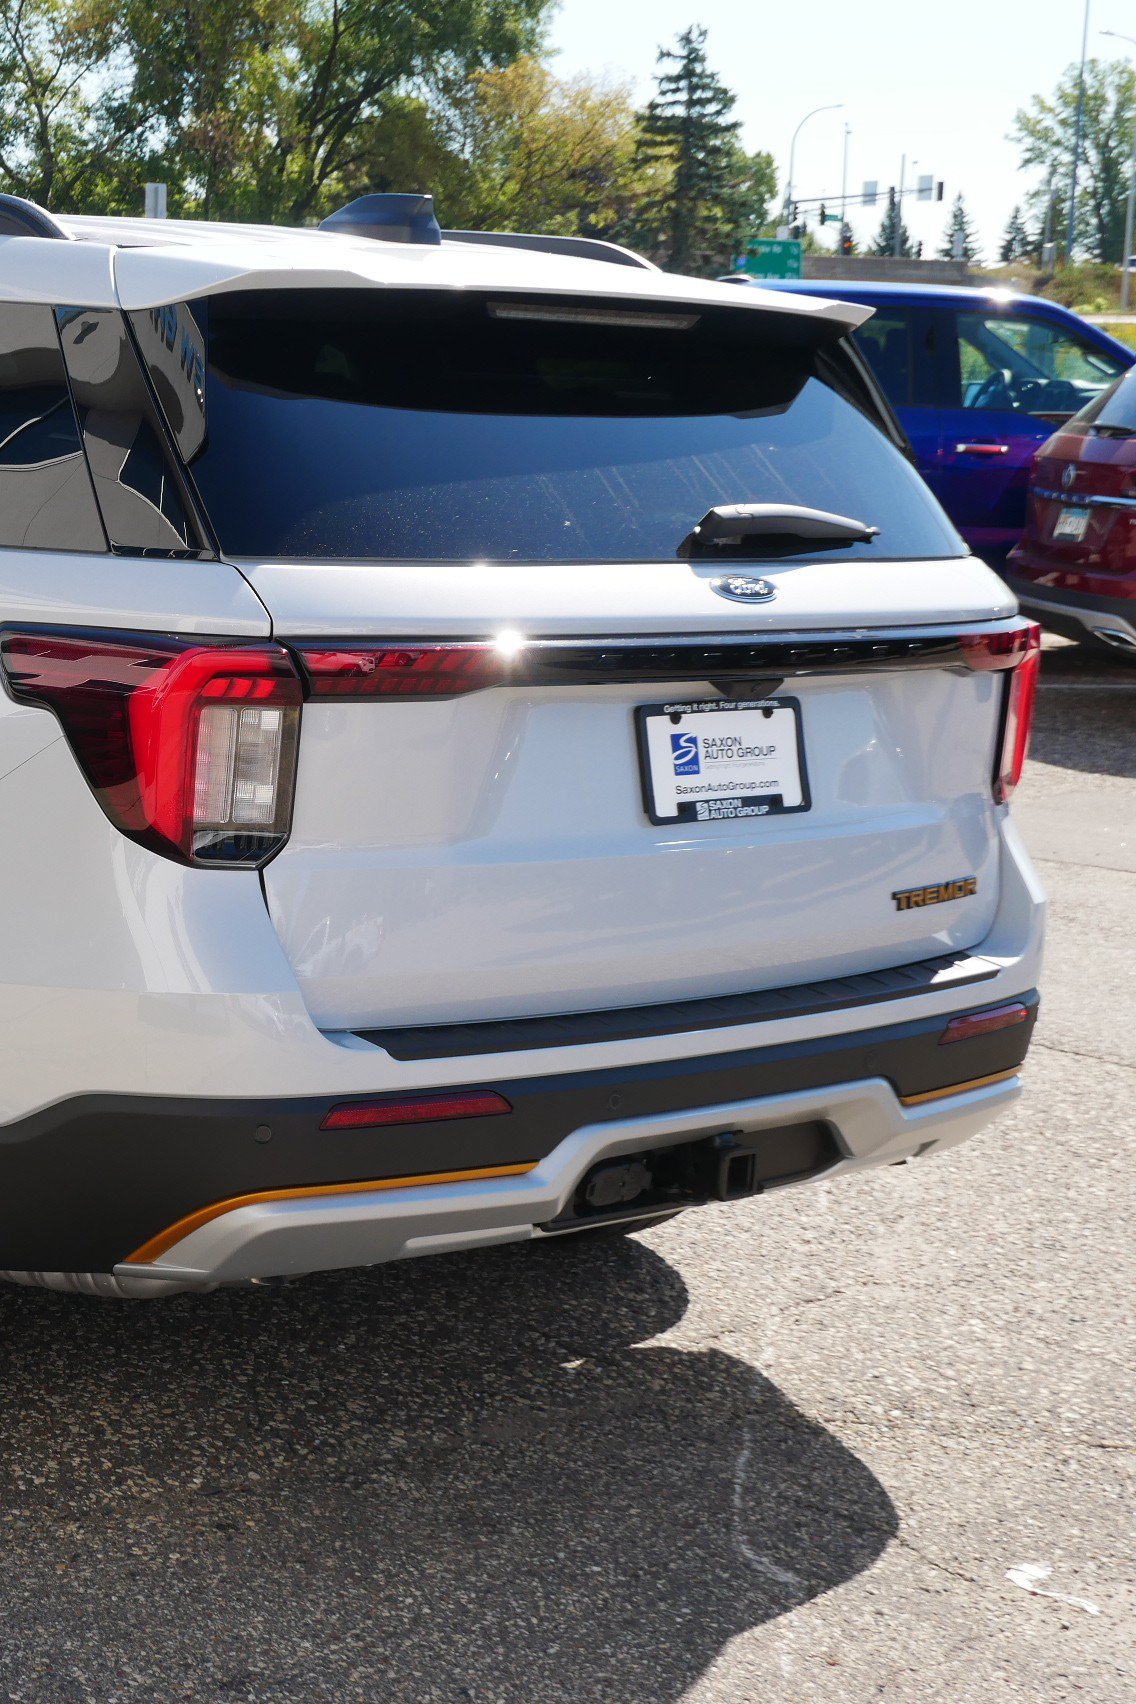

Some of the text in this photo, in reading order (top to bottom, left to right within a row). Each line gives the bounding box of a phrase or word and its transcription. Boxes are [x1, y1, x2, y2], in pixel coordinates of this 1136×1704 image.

[664, 704, 692, 714] Getting
[698, 703, 718, 713] right.
[719, 701, 736, 709] Four
[737, 700, 780, 710] generations.
[702, 736, 742, 749] SAXON
[704, 745, 776, 760] AUTO GROUP
[675, 765, 699, 773] SAXON
[675, 779, 779, 795] SaxonAutoGroup.com
[709, 799, 742, 809] SAXON
[710, 806, 769, 818] AUTO GROUP
[892, 875, 977, 911] TREMOR
